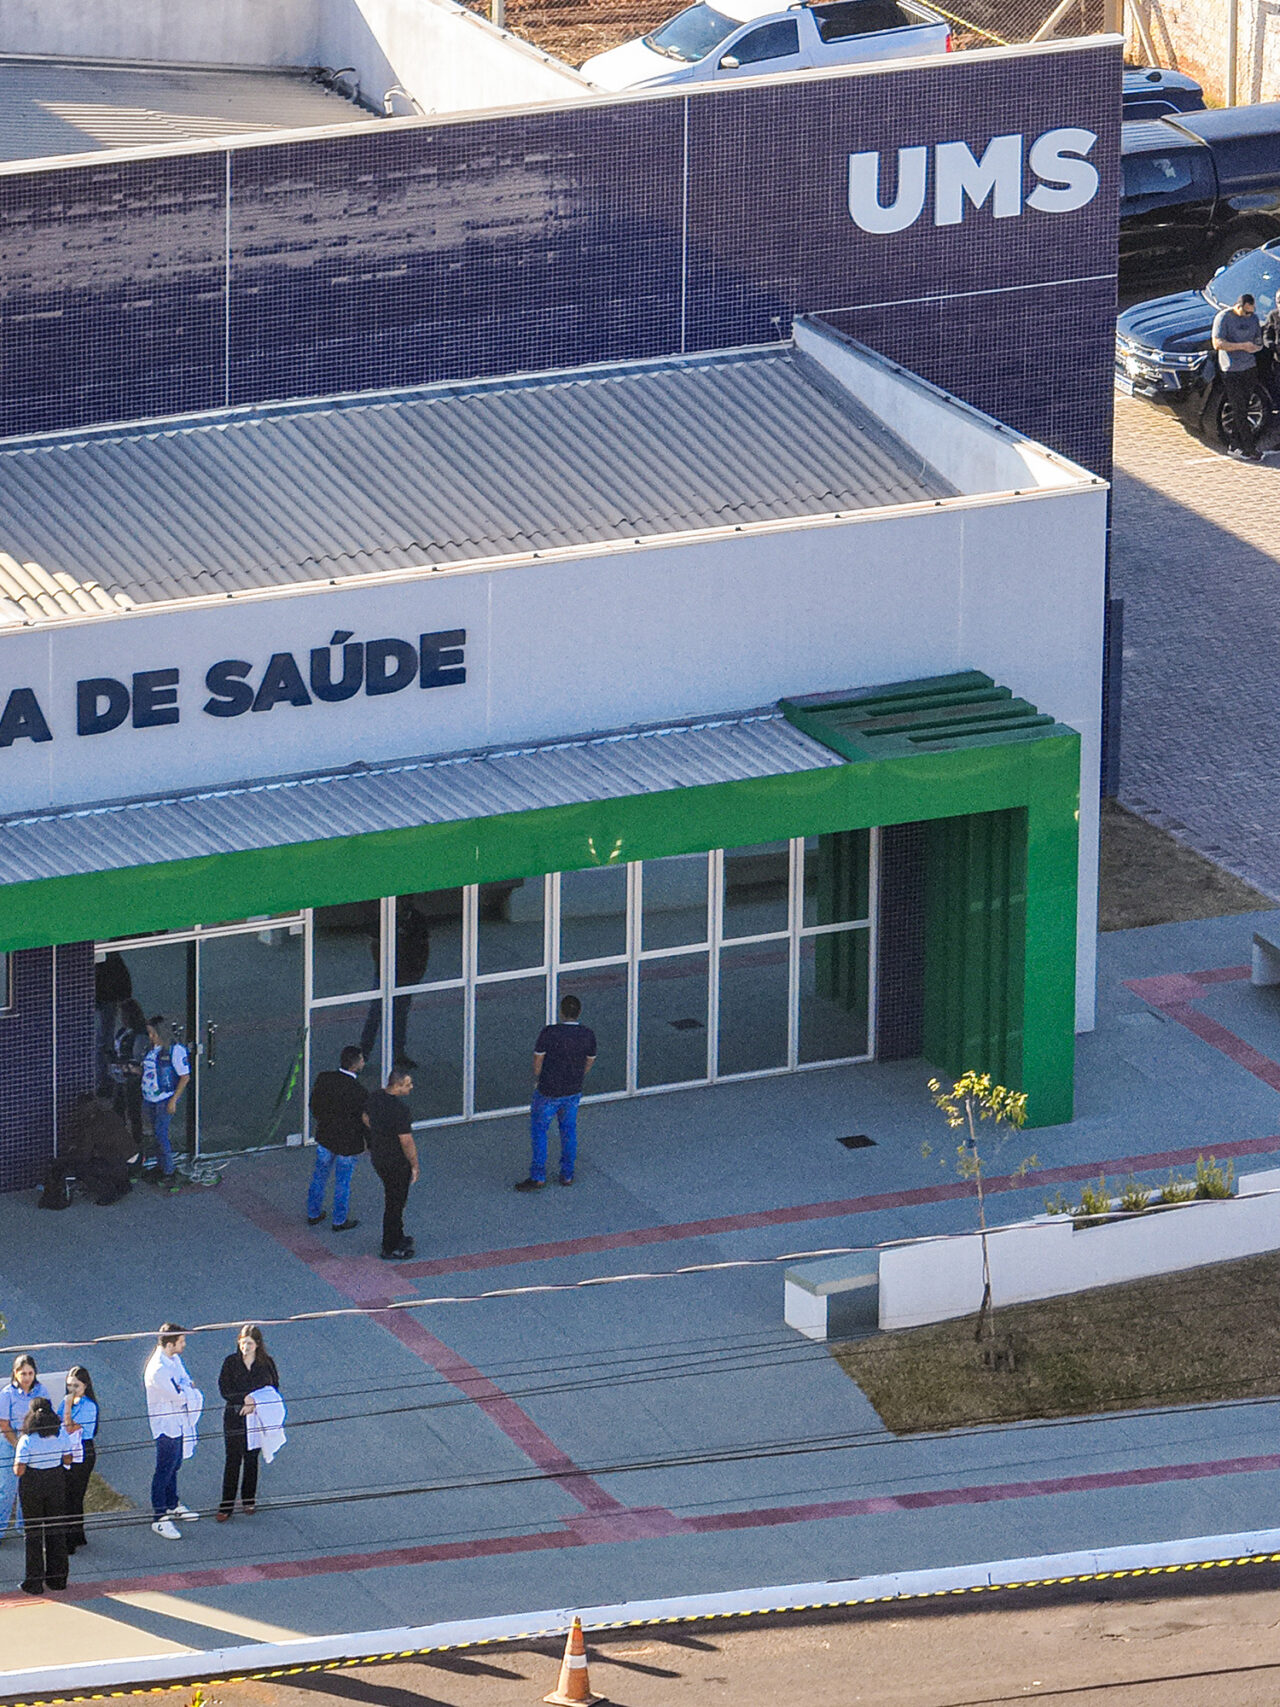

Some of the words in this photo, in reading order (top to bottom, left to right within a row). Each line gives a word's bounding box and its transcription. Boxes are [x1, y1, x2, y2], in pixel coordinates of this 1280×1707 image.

[848, 127, 1099, 235] UMS
[76, 667, 180, 737] DE
[202, 629, 467, 718] SAÚDE
